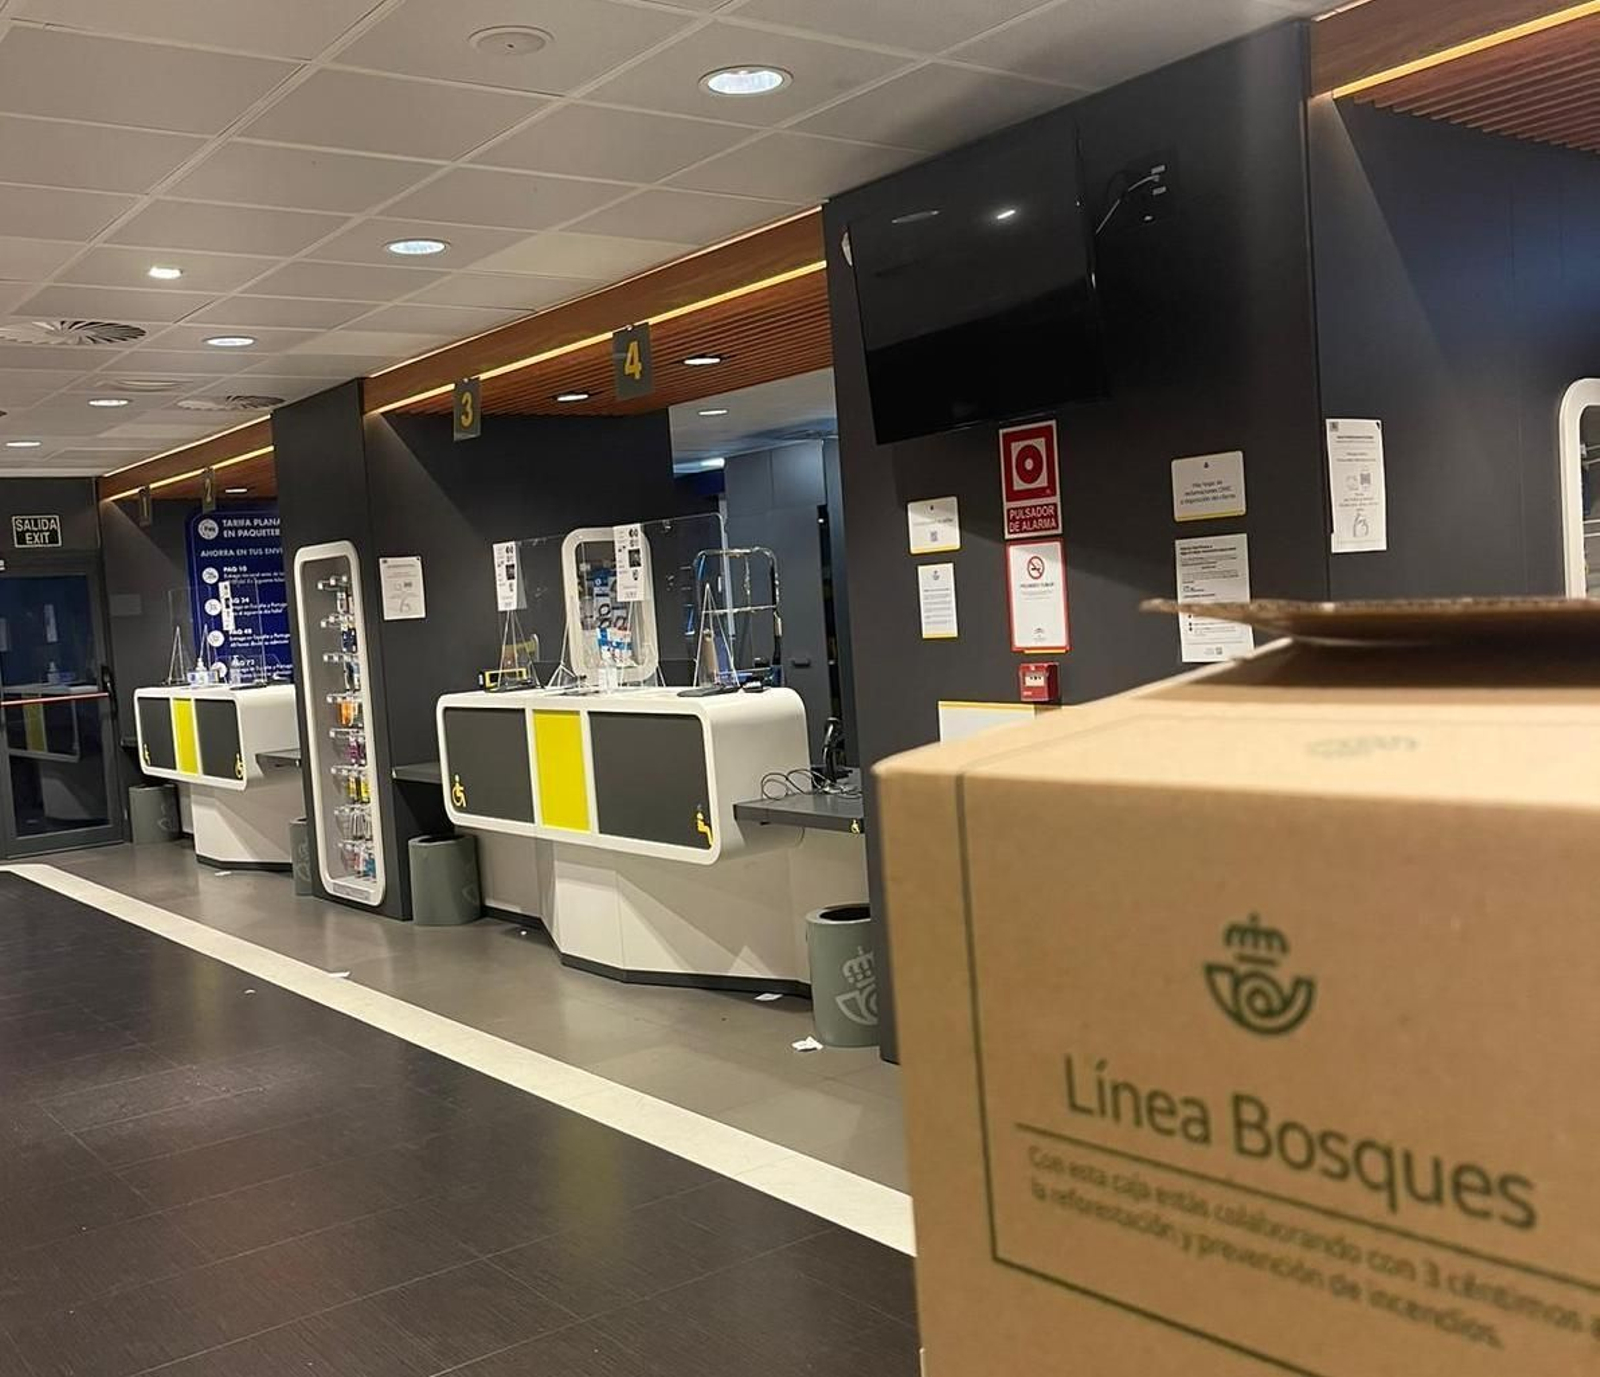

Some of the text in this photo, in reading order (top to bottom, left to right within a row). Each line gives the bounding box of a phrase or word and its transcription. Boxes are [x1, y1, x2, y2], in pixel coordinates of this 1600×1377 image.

[625, 341, 642, 379] 4
[461, 391, 473, 427] 3
[1009, 505, 1055, 521] PULSADOR
[15, 519, 57, 532] SALIDA
[222, 518, 252, 527] TARIFA
[1009, 517, 1057, 533] DE ALARMA
[25, 532, 50, 544] EXIT
[222, 529, 236, 538] EN
[200, 548, 235, 558] AHORRA
[236, 548, 247, 556] EN
[249, 547, 263, 556] TUS
[1064, 1053, 1537, 1231] Línea Bosques
[1028, 1145, 1065, 1175] Con
[1068, 1161, 1107, 1187] esta
[1111, 1171, 1151, 1202] caja
[1213, 1202, 1362, 1265] colaborando
[1366, 1249, 1417, 1283] con
[1423, 1257, 1441, 1290] 3
[1447, 1268, 1585, 1333] céntimos
[1030, 1176, 1048, 1202] la
[1050, 1186, 1176, 1240] reforestación
[1196, 1232, 1325, 1289] prevención
[1328, 1271, 1362, 1301] de
